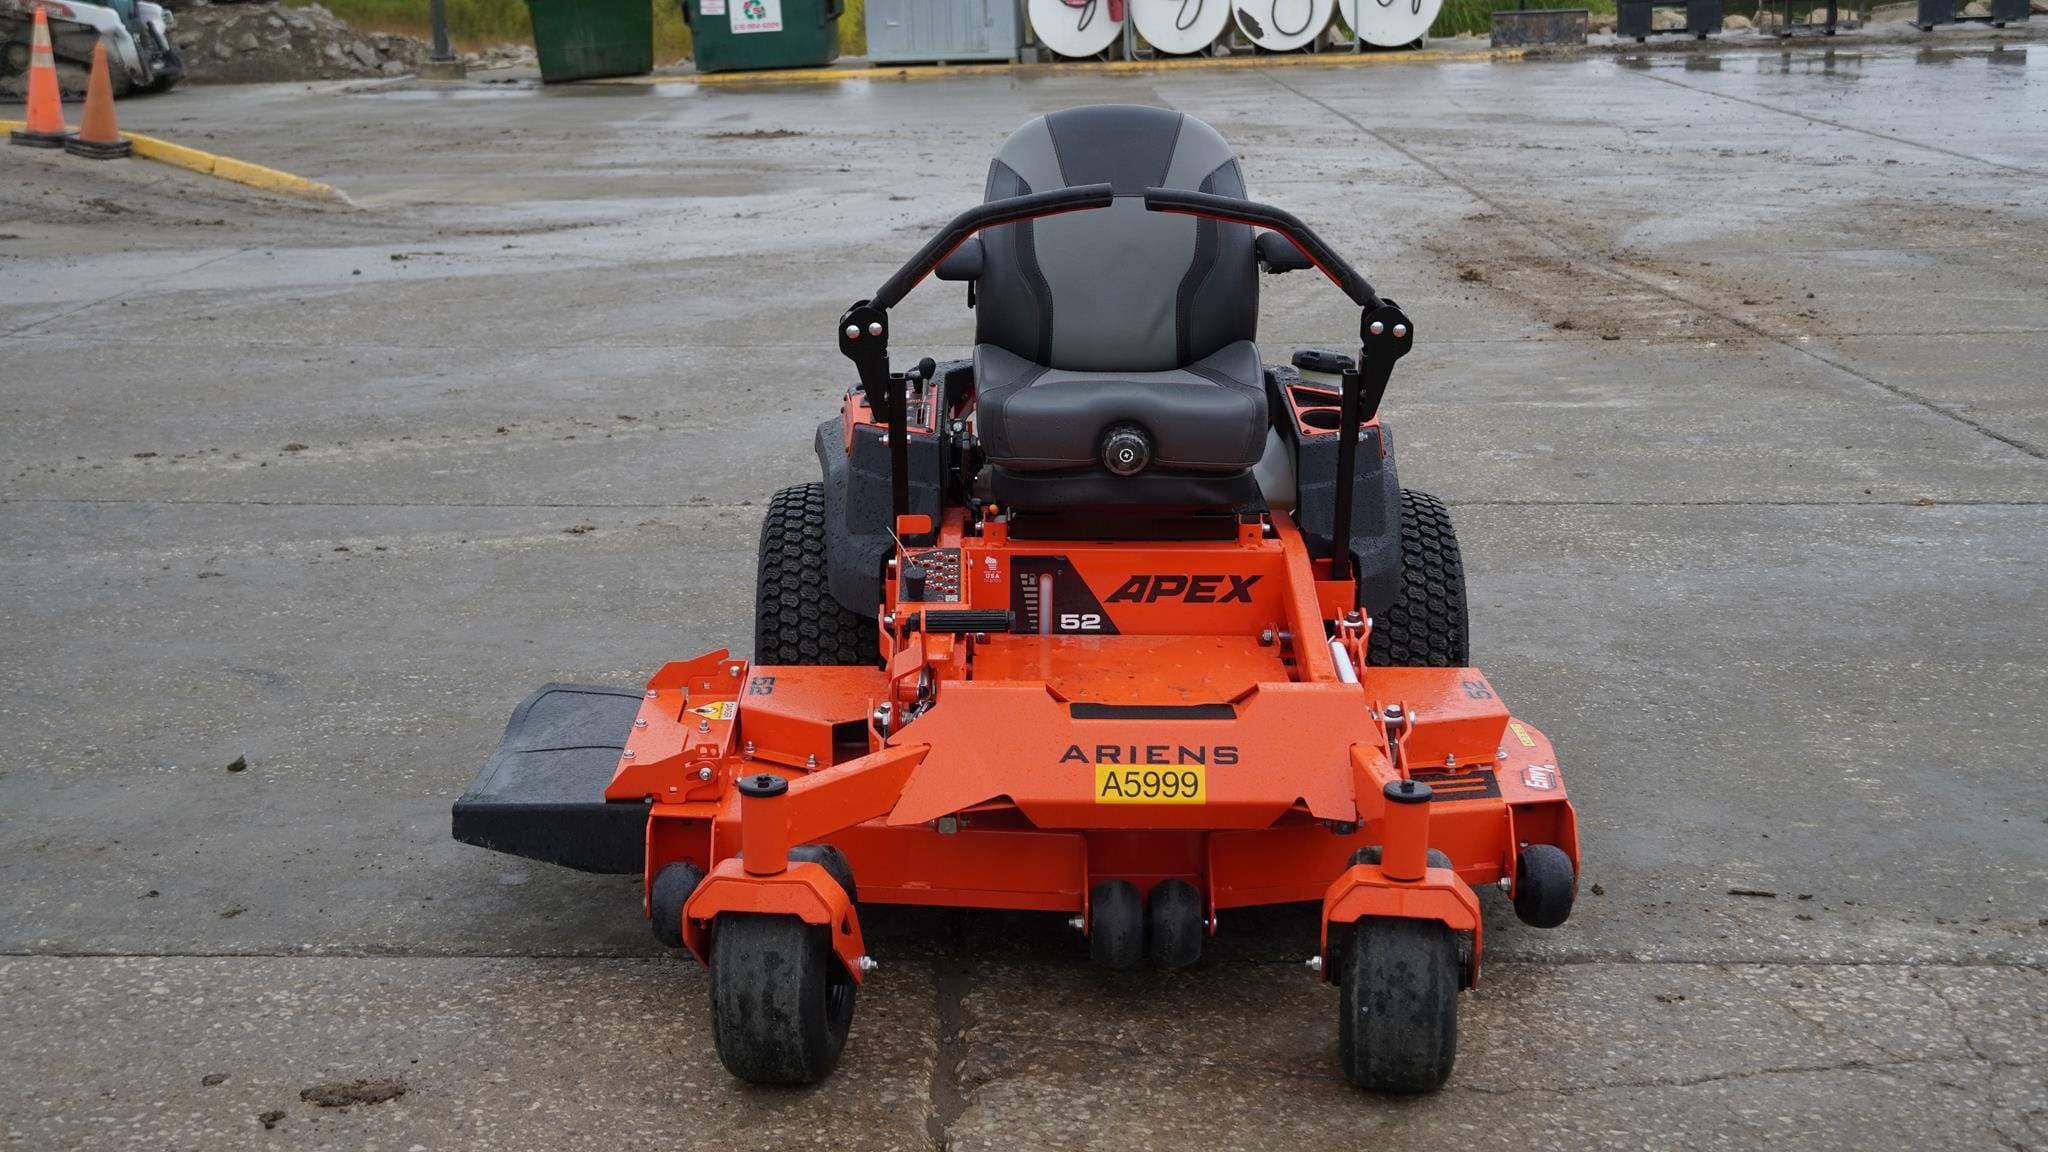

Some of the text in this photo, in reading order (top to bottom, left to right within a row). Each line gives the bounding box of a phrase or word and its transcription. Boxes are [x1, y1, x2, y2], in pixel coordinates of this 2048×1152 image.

[1104, 575, 1264, 603] APEX
[1061, 614, 1101, 630] 52
[752, 677, 776, 695] 52
[1463, 681, 1492, 699] 52
[1060, 744, 1239, 764] ARIENS
[1101, 771, 1198, 798] A5999
